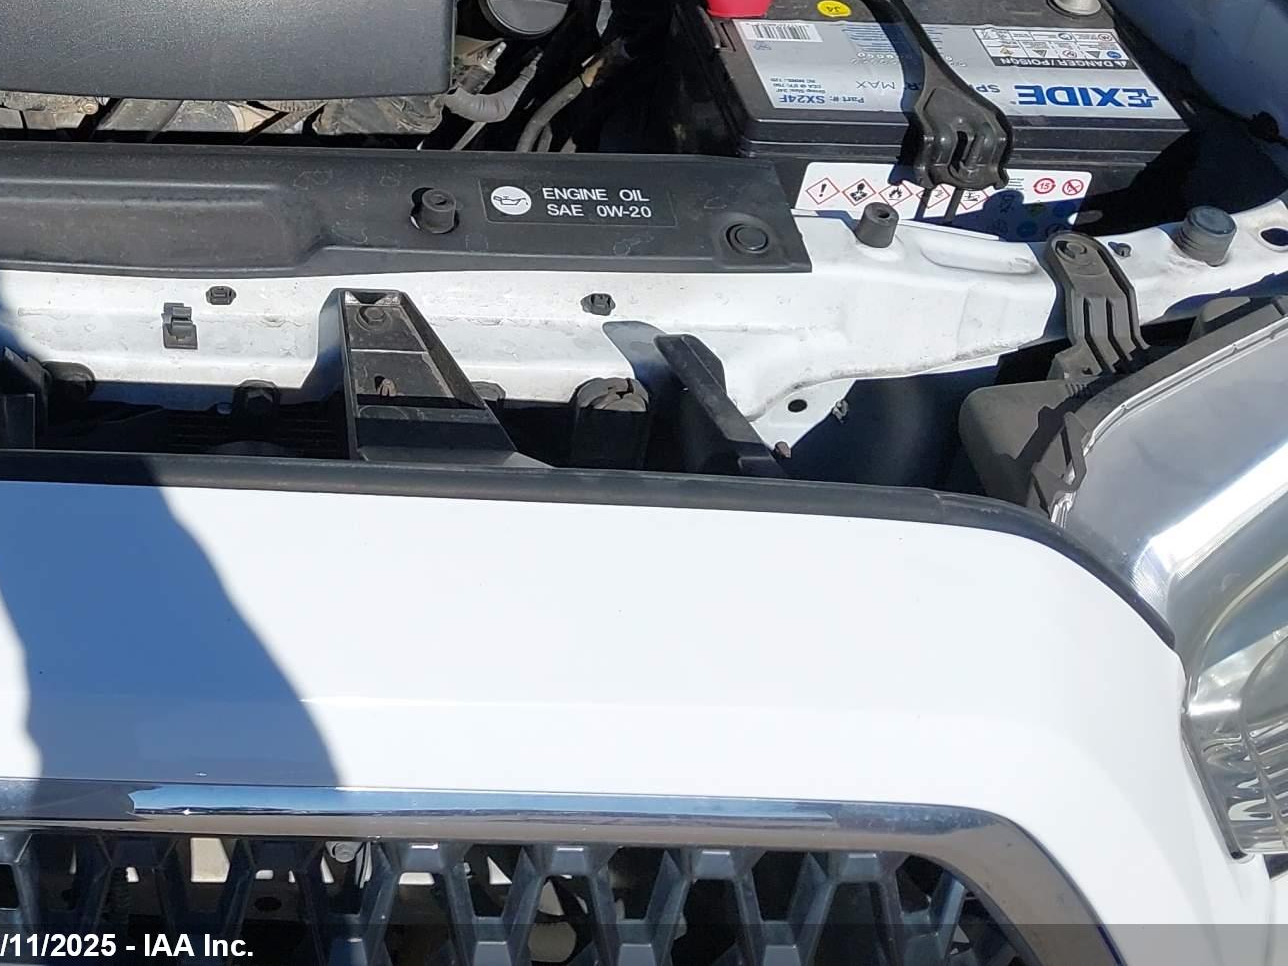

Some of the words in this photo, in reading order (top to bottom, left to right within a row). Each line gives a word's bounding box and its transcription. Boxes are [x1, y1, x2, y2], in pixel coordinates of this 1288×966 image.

[1000, 57, 1051, 67] POISON
[1056, 59, 1115, 68] DANGER
[856, 80, 896, 90] MAX
[779, 94, 825, 104] SX24F
[843, 96, 865, 104] Part
[1014, 84, 1159, 108] EXIDE
[542, 187, 608, 201] ENGINE
[619, 189, 650, 202] OIL
[546, 203, 584, 216] SAE
[596, 205, 652, 218] 0W-20
